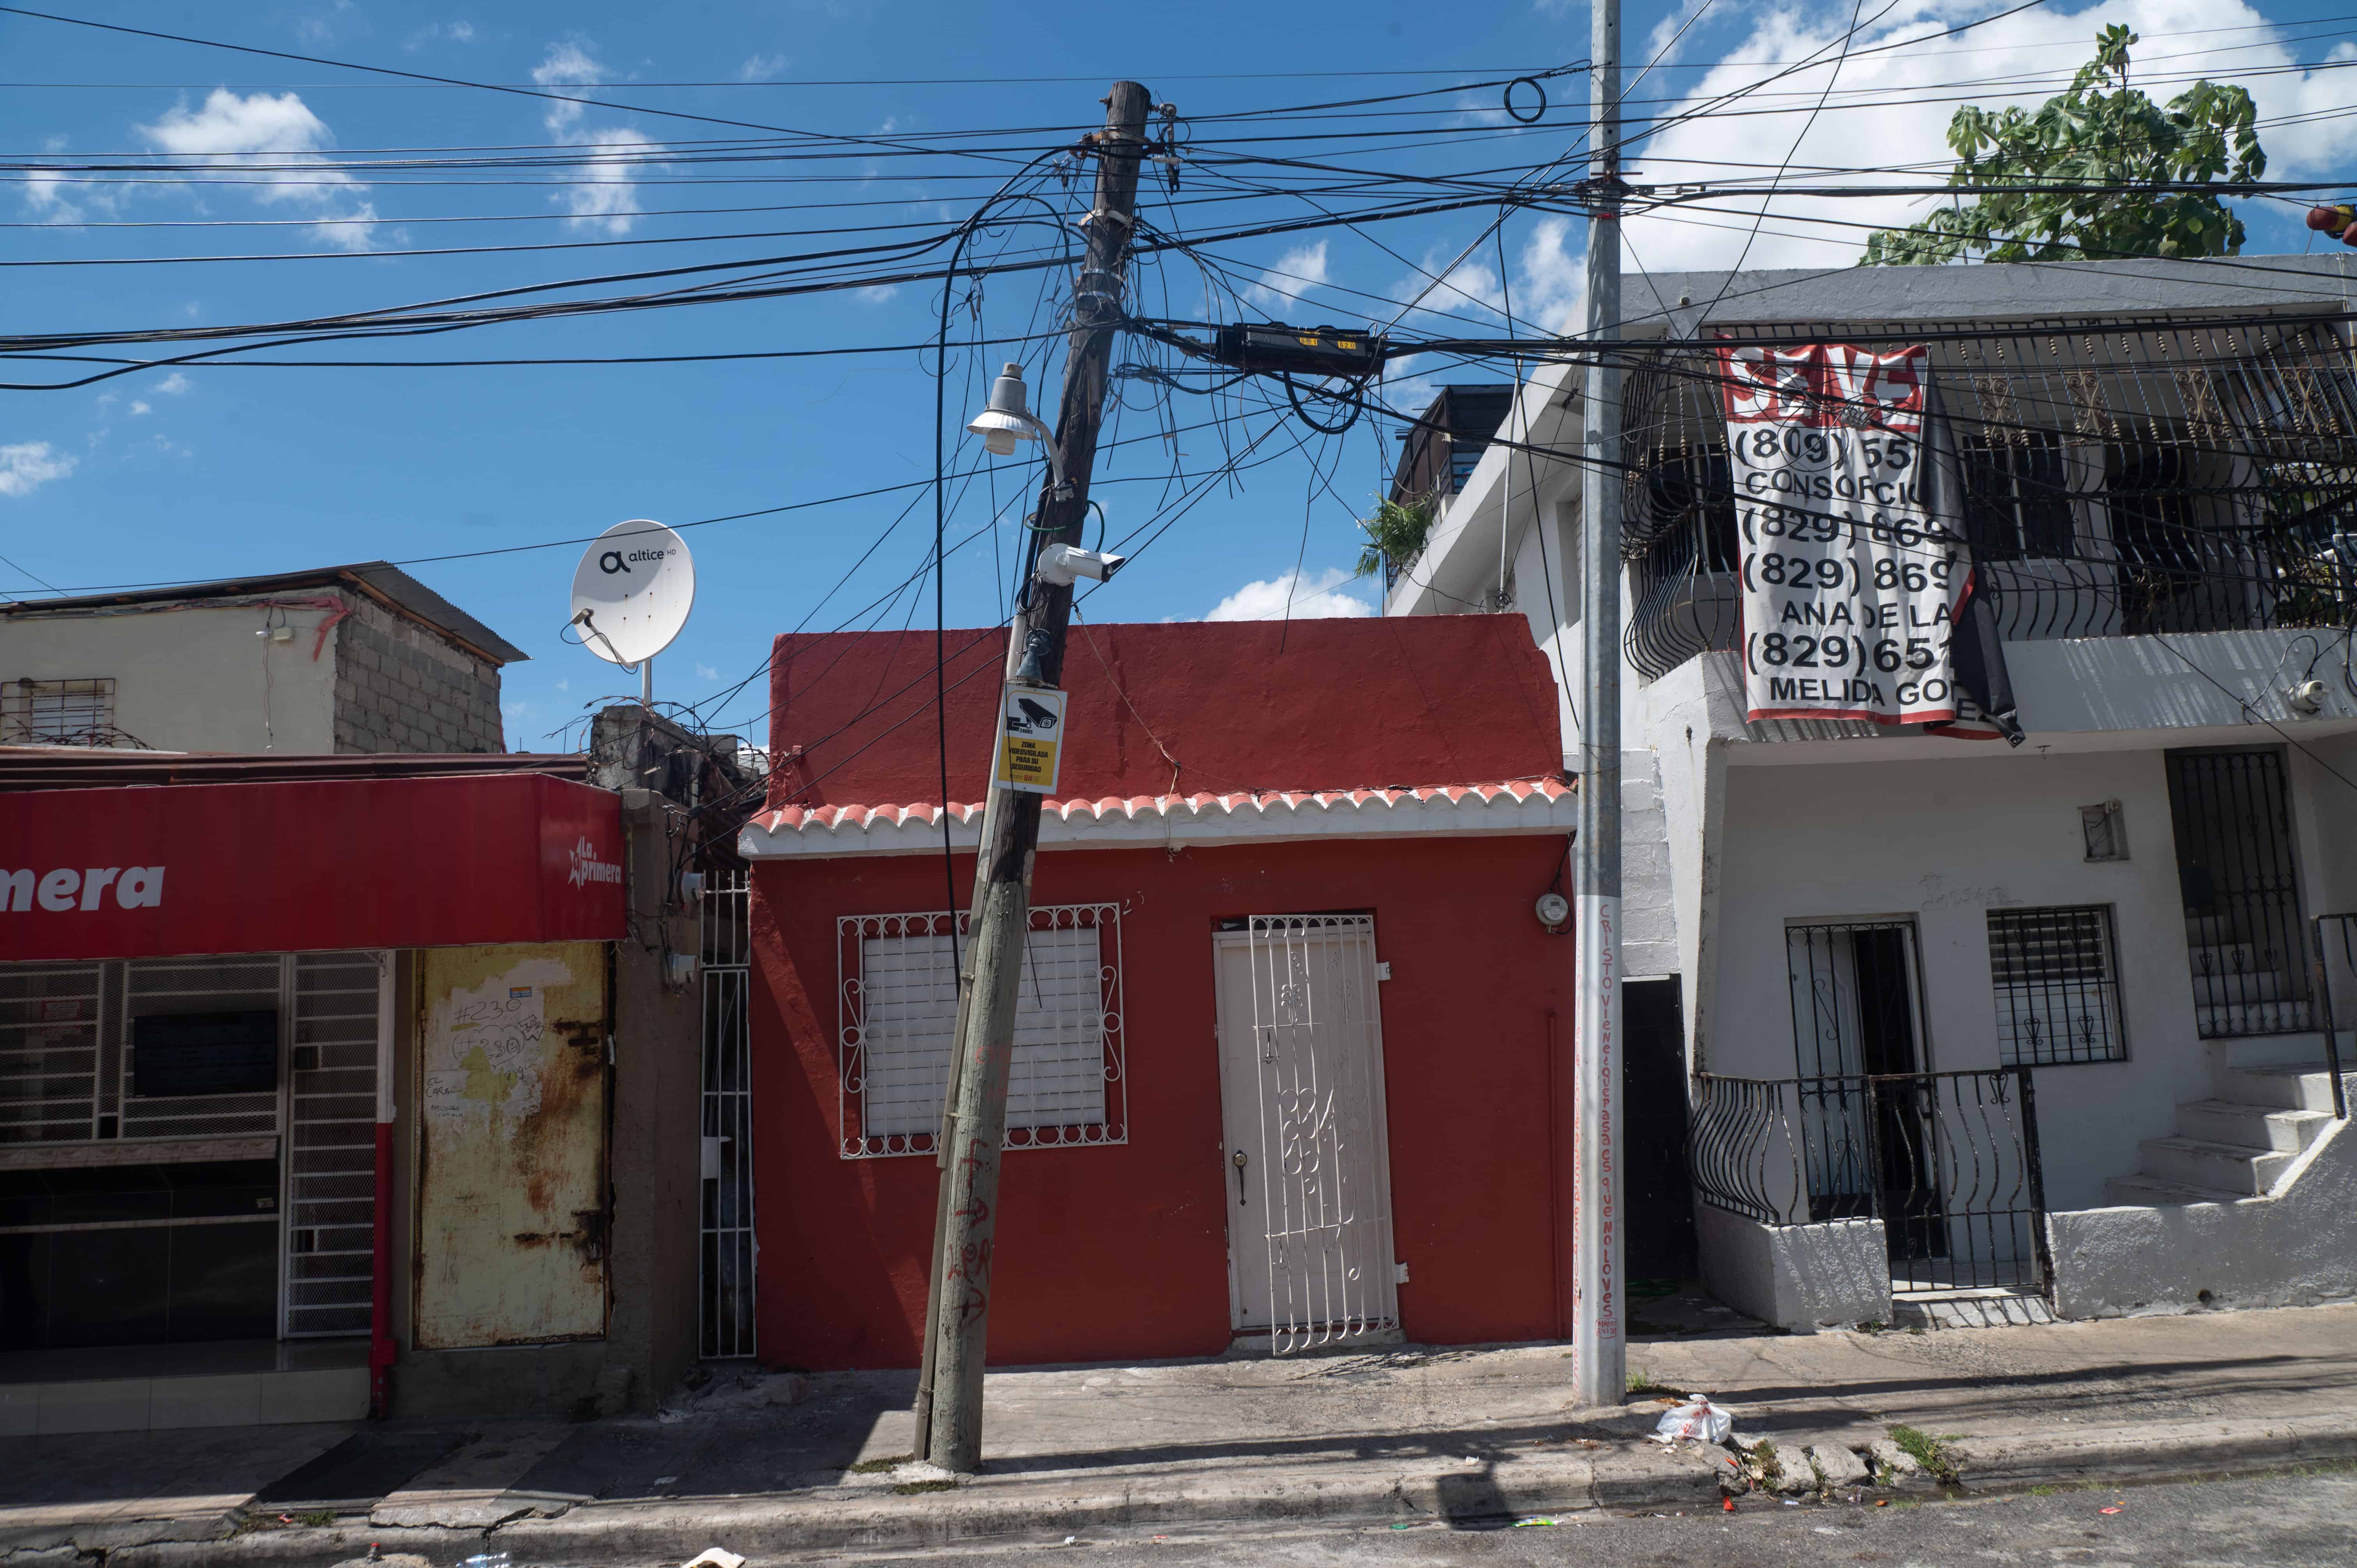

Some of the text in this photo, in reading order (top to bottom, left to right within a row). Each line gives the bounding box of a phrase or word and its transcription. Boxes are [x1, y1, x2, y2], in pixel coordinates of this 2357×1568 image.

[1735, 428, 1844, 470] (809)
[1742, 506, 1856, 549] (829)
[629, 549, 664, 562] altice
[1743, 553, 1861, 597] (829)
[1781, 600, 1854, 626] ANA
[1909, 602, 1952, 627] LA
[1009, 748, 1048, 758] VIDEOVIGILADA
[1011, 763, 1041, 773] SEGURIDAD
[581, 836, 593, 859] La
[581, 851, 621, 886] primera
